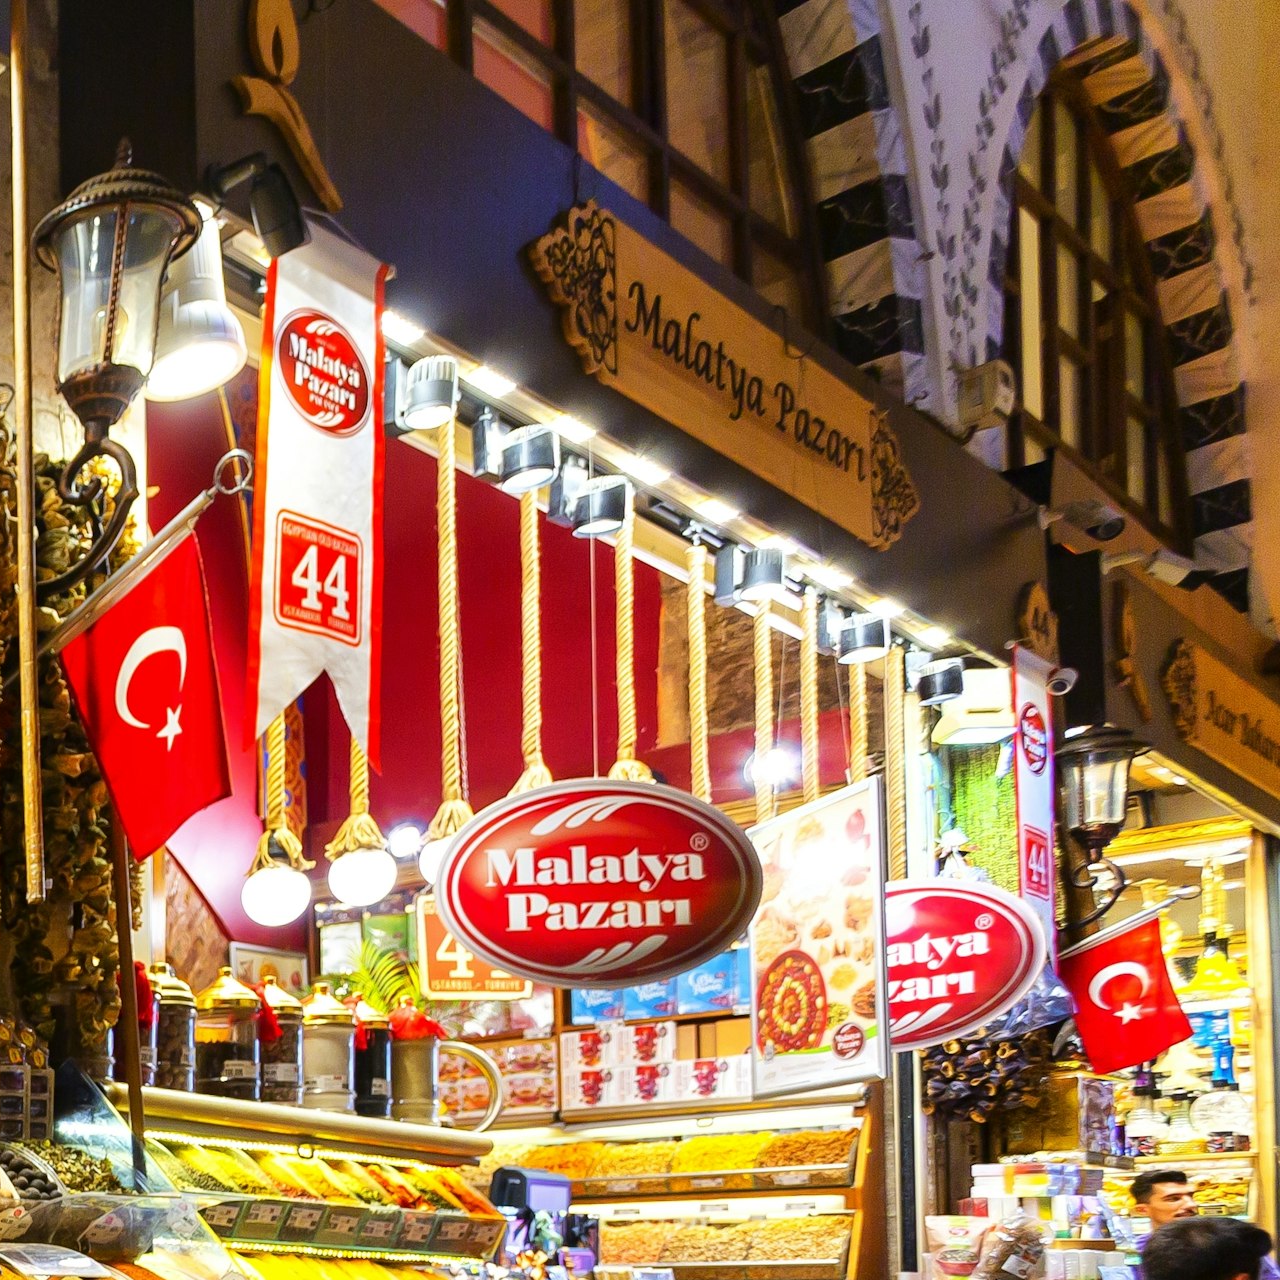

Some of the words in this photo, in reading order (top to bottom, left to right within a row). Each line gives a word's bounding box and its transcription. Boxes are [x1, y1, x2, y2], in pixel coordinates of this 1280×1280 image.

[289, 333, 360, 388] Malatya
[625, 282, 765, 420] Malatya
[774, 382, 866, 482] Pazarı
[295, 362, 355, 410] Pazarı
[292, 544, 349, 621] 44
[485, 845, 706, 892] Malatya
[1029, 842, 1046, 885] 44
[505, 893, 692, 932] Pazarı
